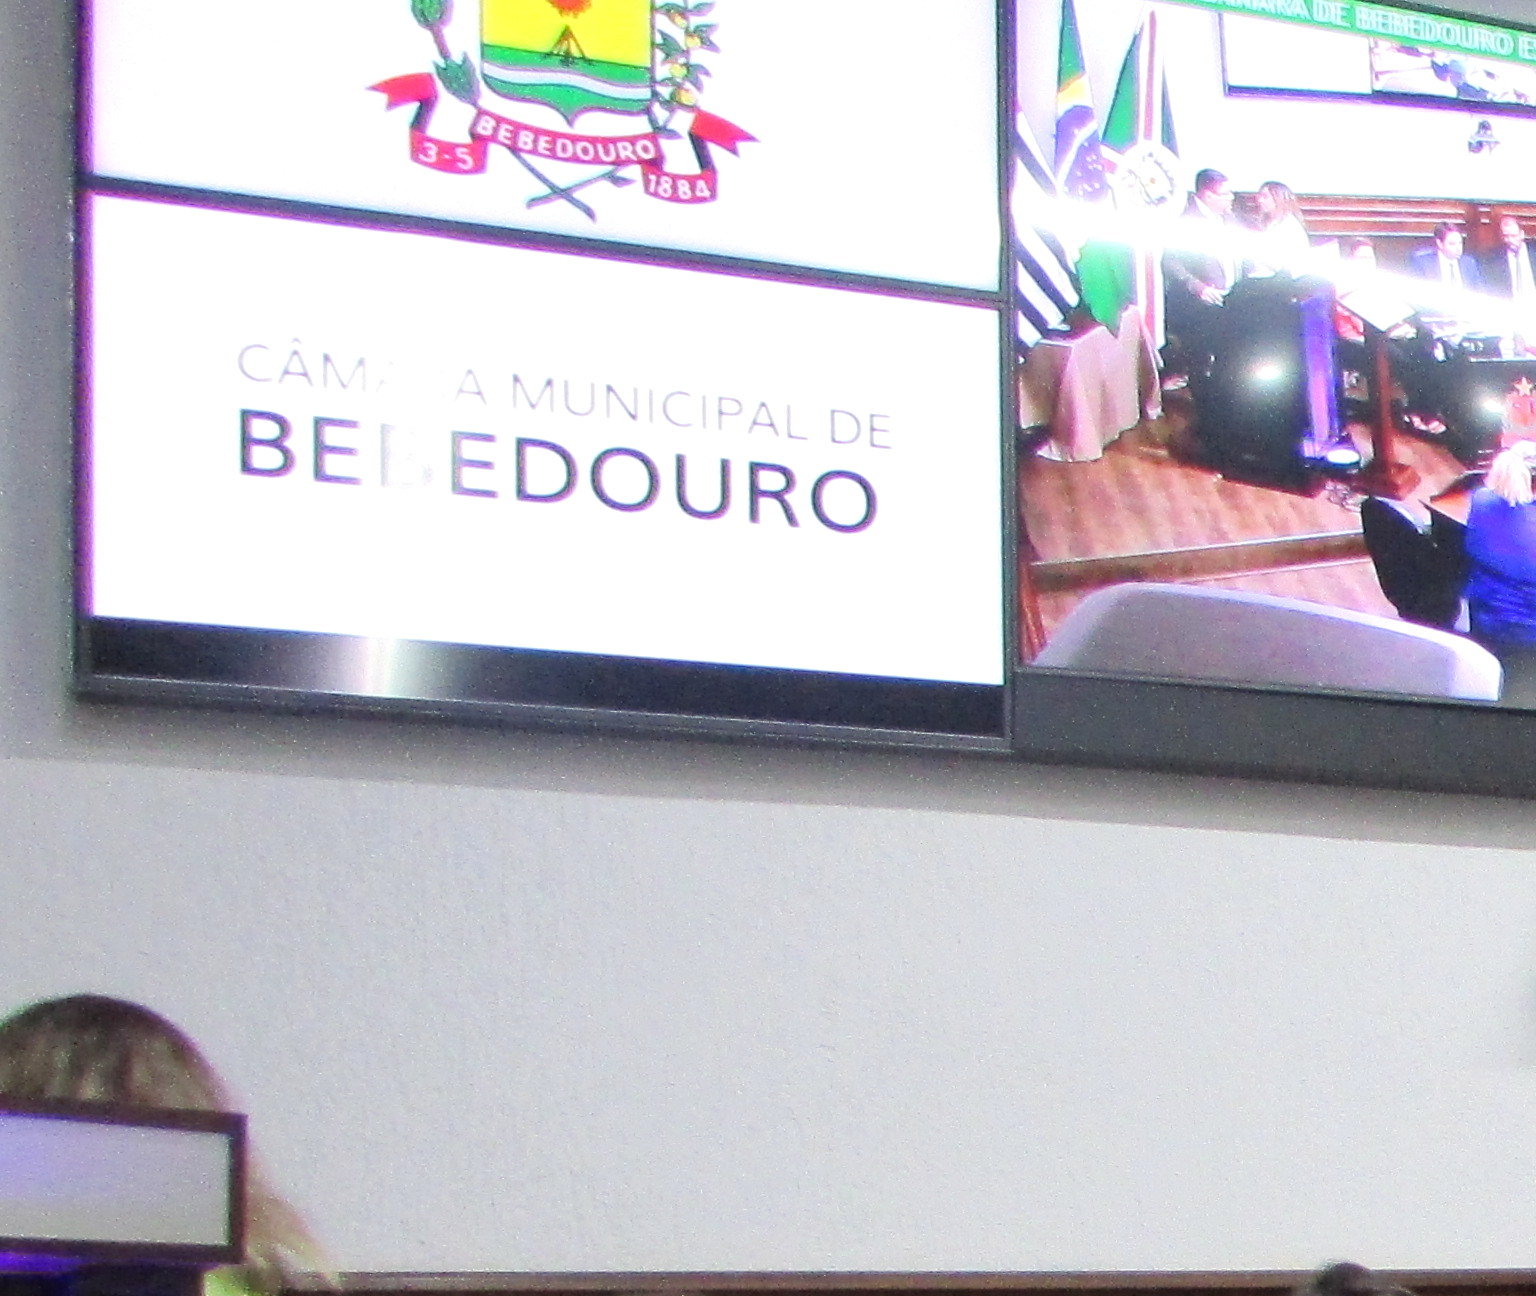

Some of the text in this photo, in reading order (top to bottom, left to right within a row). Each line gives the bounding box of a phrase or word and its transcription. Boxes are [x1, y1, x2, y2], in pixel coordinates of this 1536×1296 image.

[1313, 1, 1351, 28] DE
[1355, 8, 1514, 57] BEBEDOURO
[418, 142, 475, 171] 3-5
[475, 114, 656, 161] BEBEDOURO
[647, 173, 713, 201] 1884
[237, 337, 893, 450] CÂMA MUNICIPAL DE
